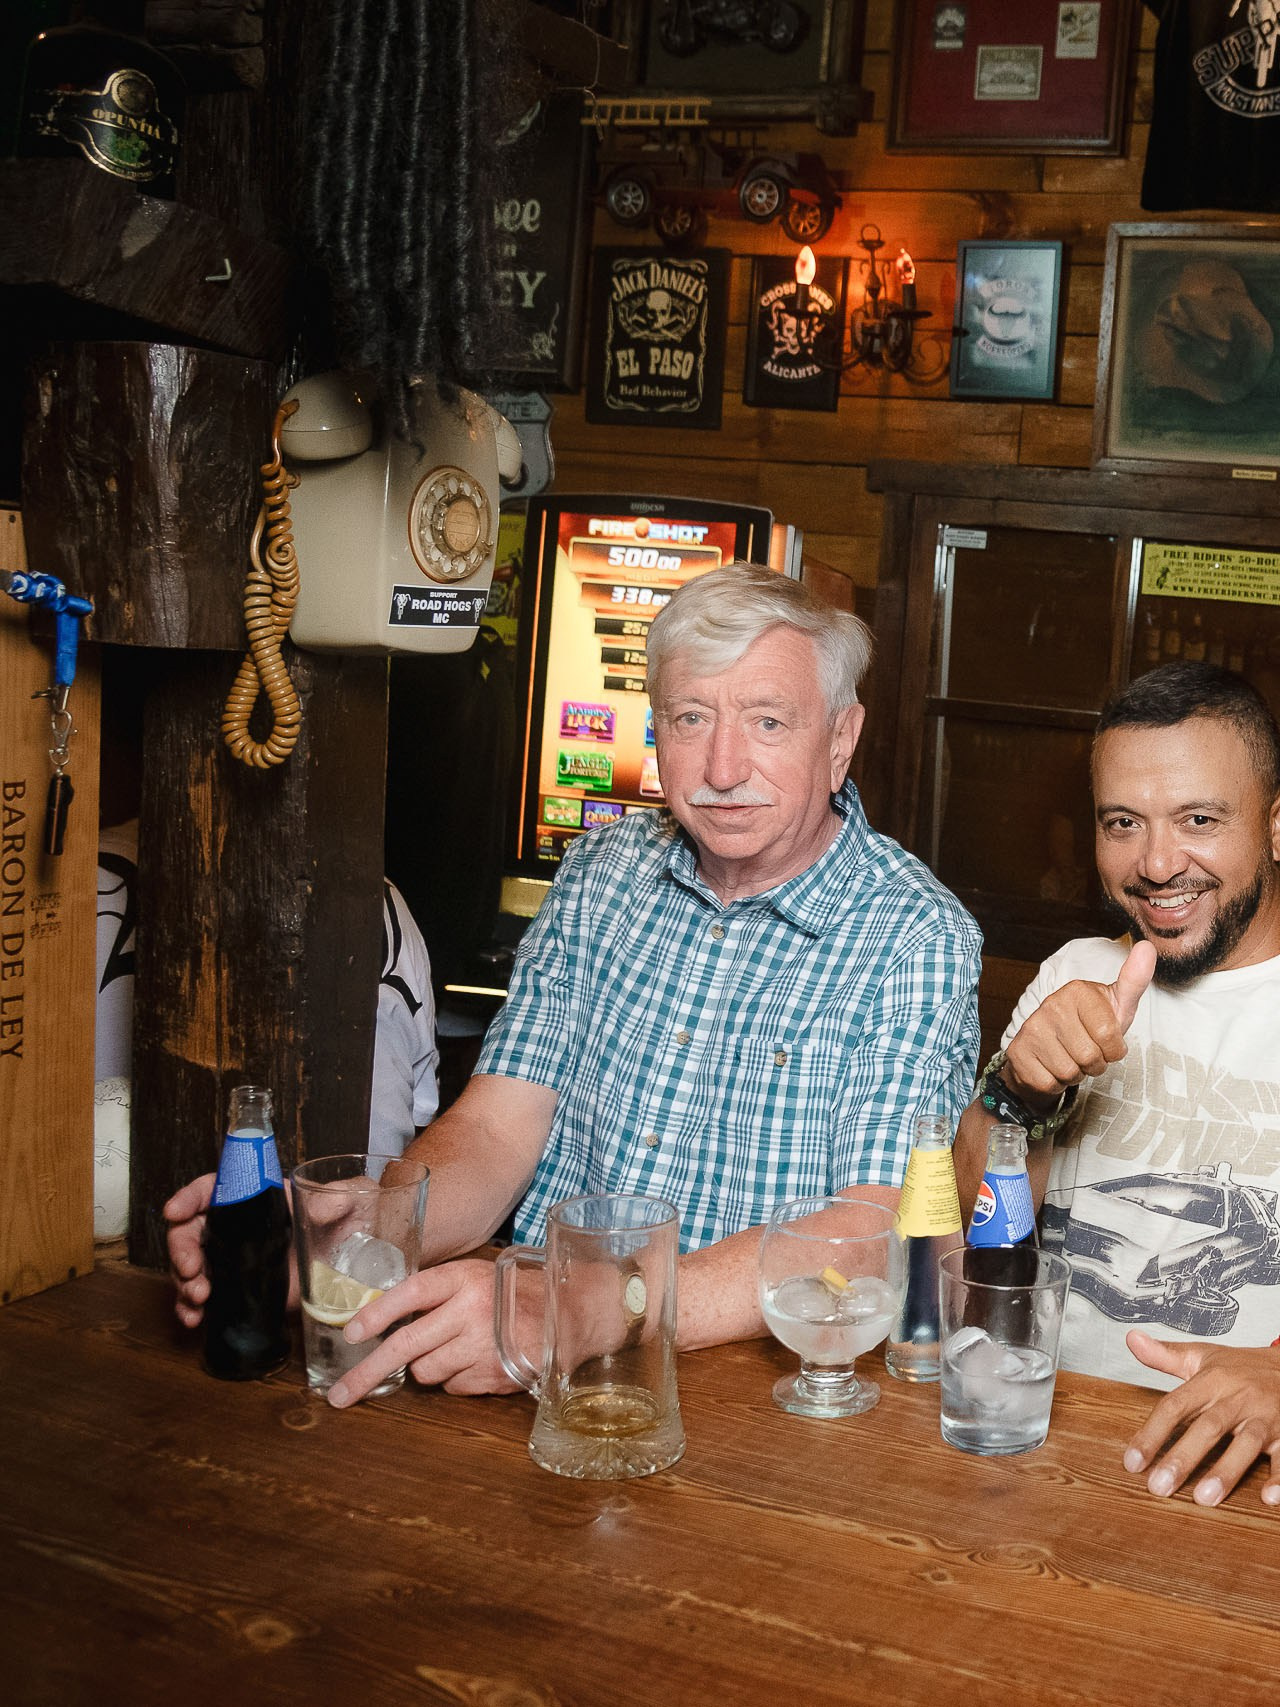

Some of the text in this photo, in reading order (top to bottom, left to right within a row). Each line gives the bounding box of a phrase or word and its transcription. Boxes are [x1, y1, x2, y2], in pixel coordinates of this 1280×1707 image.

[612, 271, 648, 302] JACK
[617, 347, 694, 380] EL PASO
[763, 361, 821, 378] ALICANTE
[620, 384, 687, 398] Bad Behavior
[588, 518, 708, 542] FIRE SHOT
[1163, 550, 1190, 559] FREE
[429, 591, 458, 599] SUPPORT
[411, 599, 472, 611] ROAD HOGS
[432, 612, 450, 624] MC
[567, 714, 609, 731] LUCK
[0, 778, 27, 1060] BARON DE LEY
[976, 1199, 993, 1213] PSI
